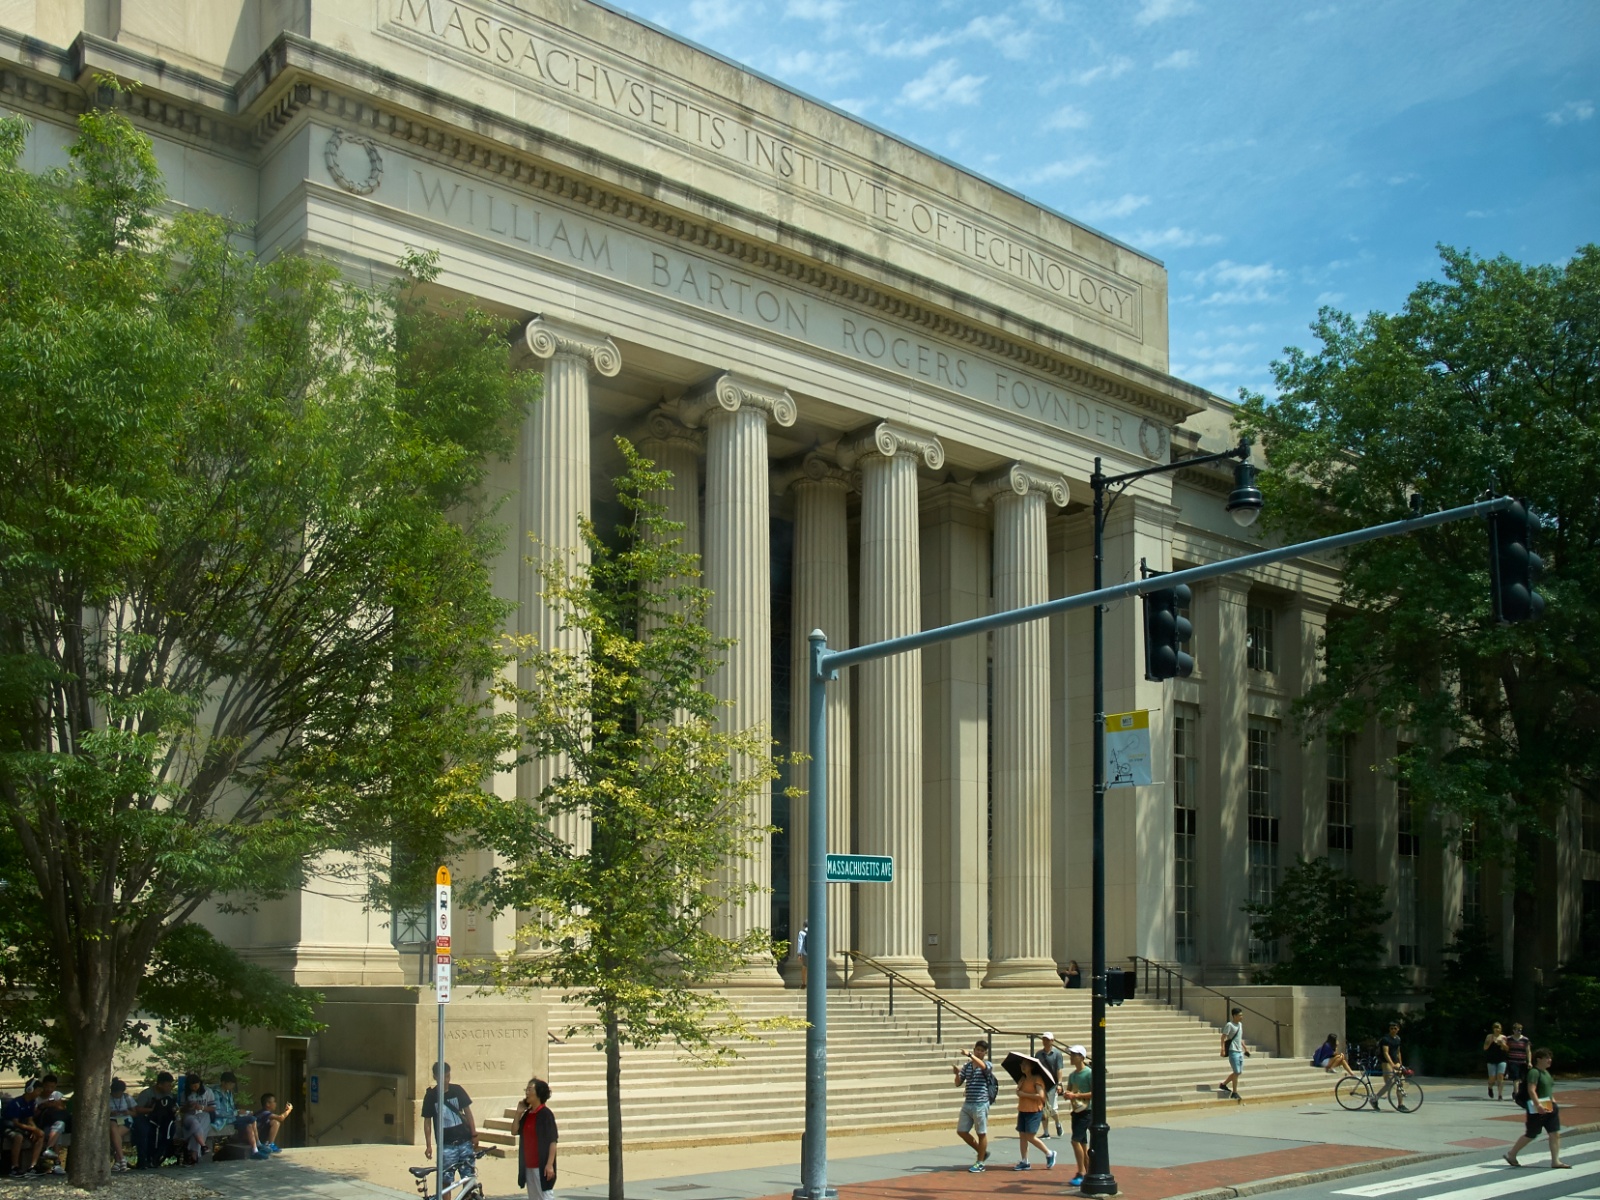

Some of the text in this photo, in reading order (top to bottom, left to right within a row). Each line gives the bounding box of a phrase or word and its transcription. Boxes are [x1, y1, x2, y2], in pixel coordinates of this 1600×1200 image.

[396, 0, 1128, 319] MASSACHVSETTS INSTITVTE OF TECHNOLOGY
[413, 169, 1126, 446] WILLIAM BARTON ROGERS FOVNDER
[827, 860, 892, 877] MASSACHUSETTS AVE
[444, 1028, 529, 1040] ASSACHVSETTS
[477, 1044, 491, 1056] 77
[461, 1060, 506, 1072] AVENVE
